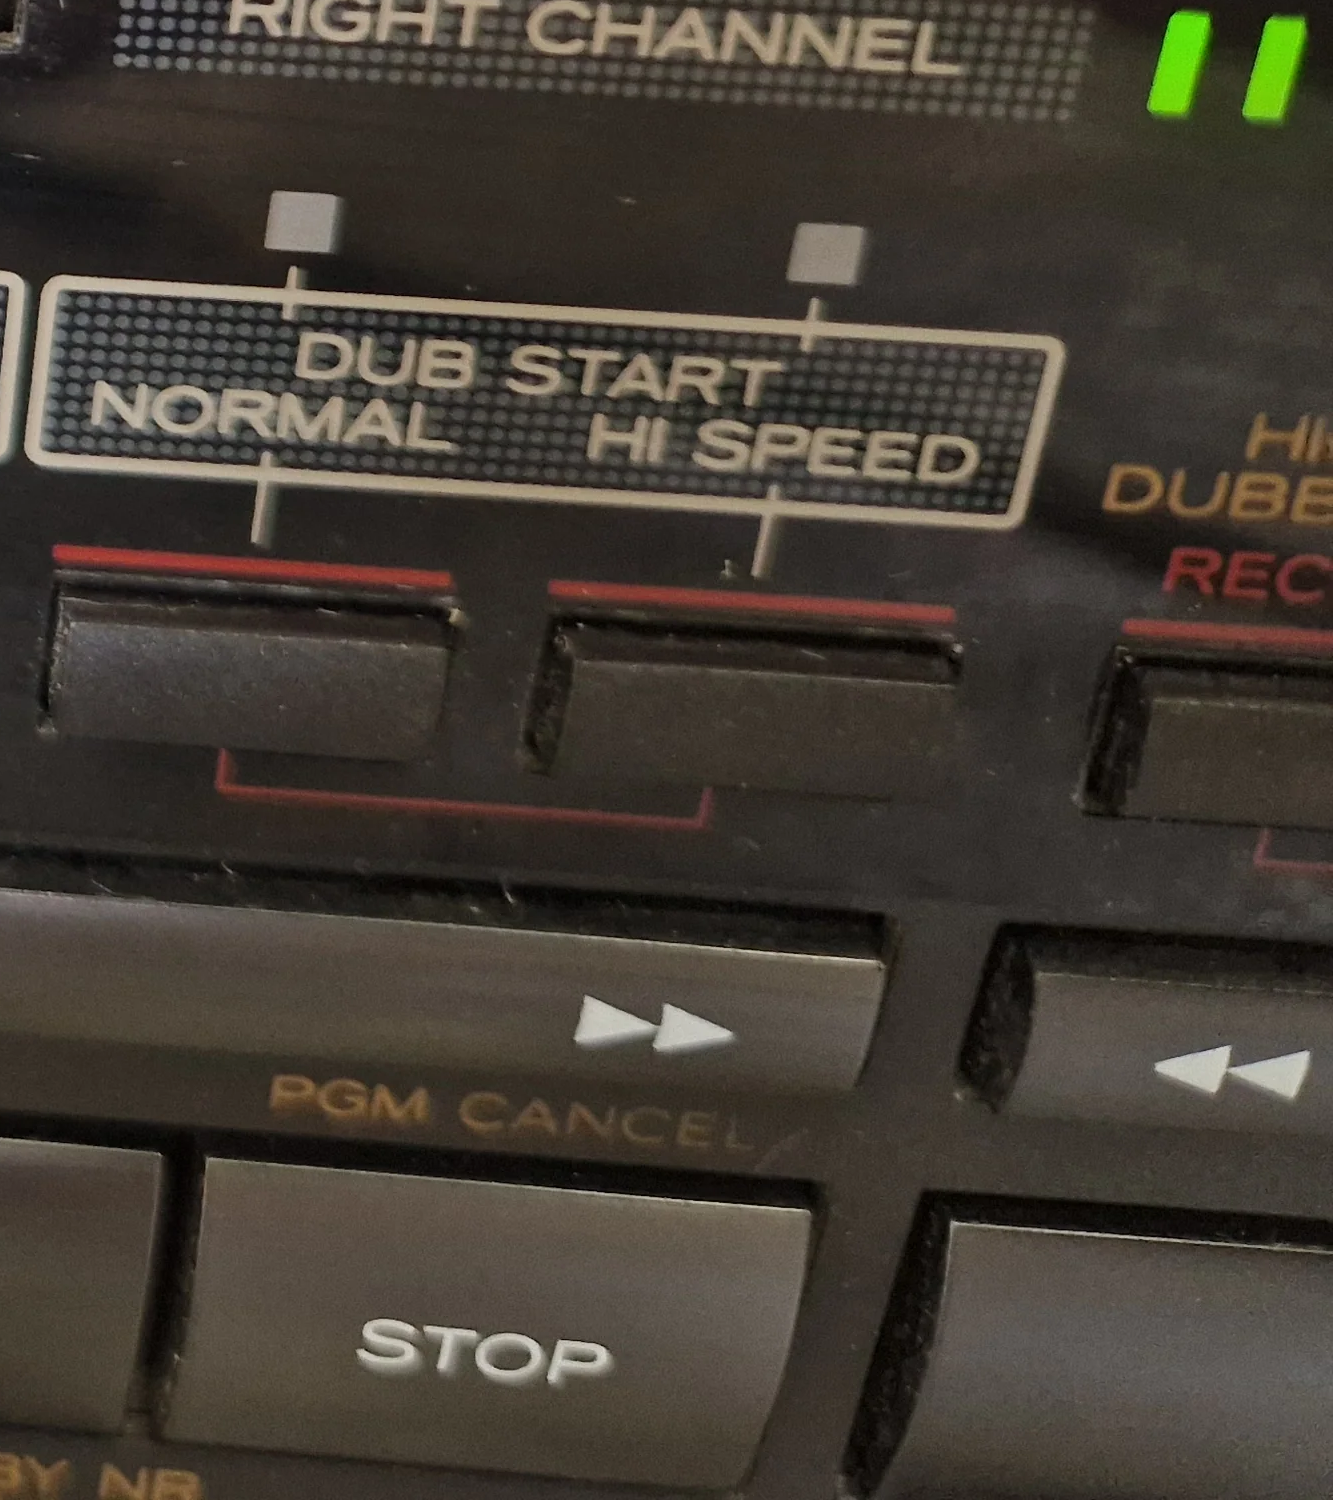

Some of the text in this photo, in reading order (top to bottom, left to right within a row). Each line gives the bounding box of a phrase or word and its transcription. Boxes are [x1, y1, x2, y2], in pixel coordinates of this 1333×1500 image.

[294, 332, 783, 408] DUB START
[91, 381, 980, 484] NORMAL HI SPEED
[1245, 410, 1333, 463] HI
[268, 1073, 430, 1125] PGM
[354, 1316, 615, 1388] STOP
